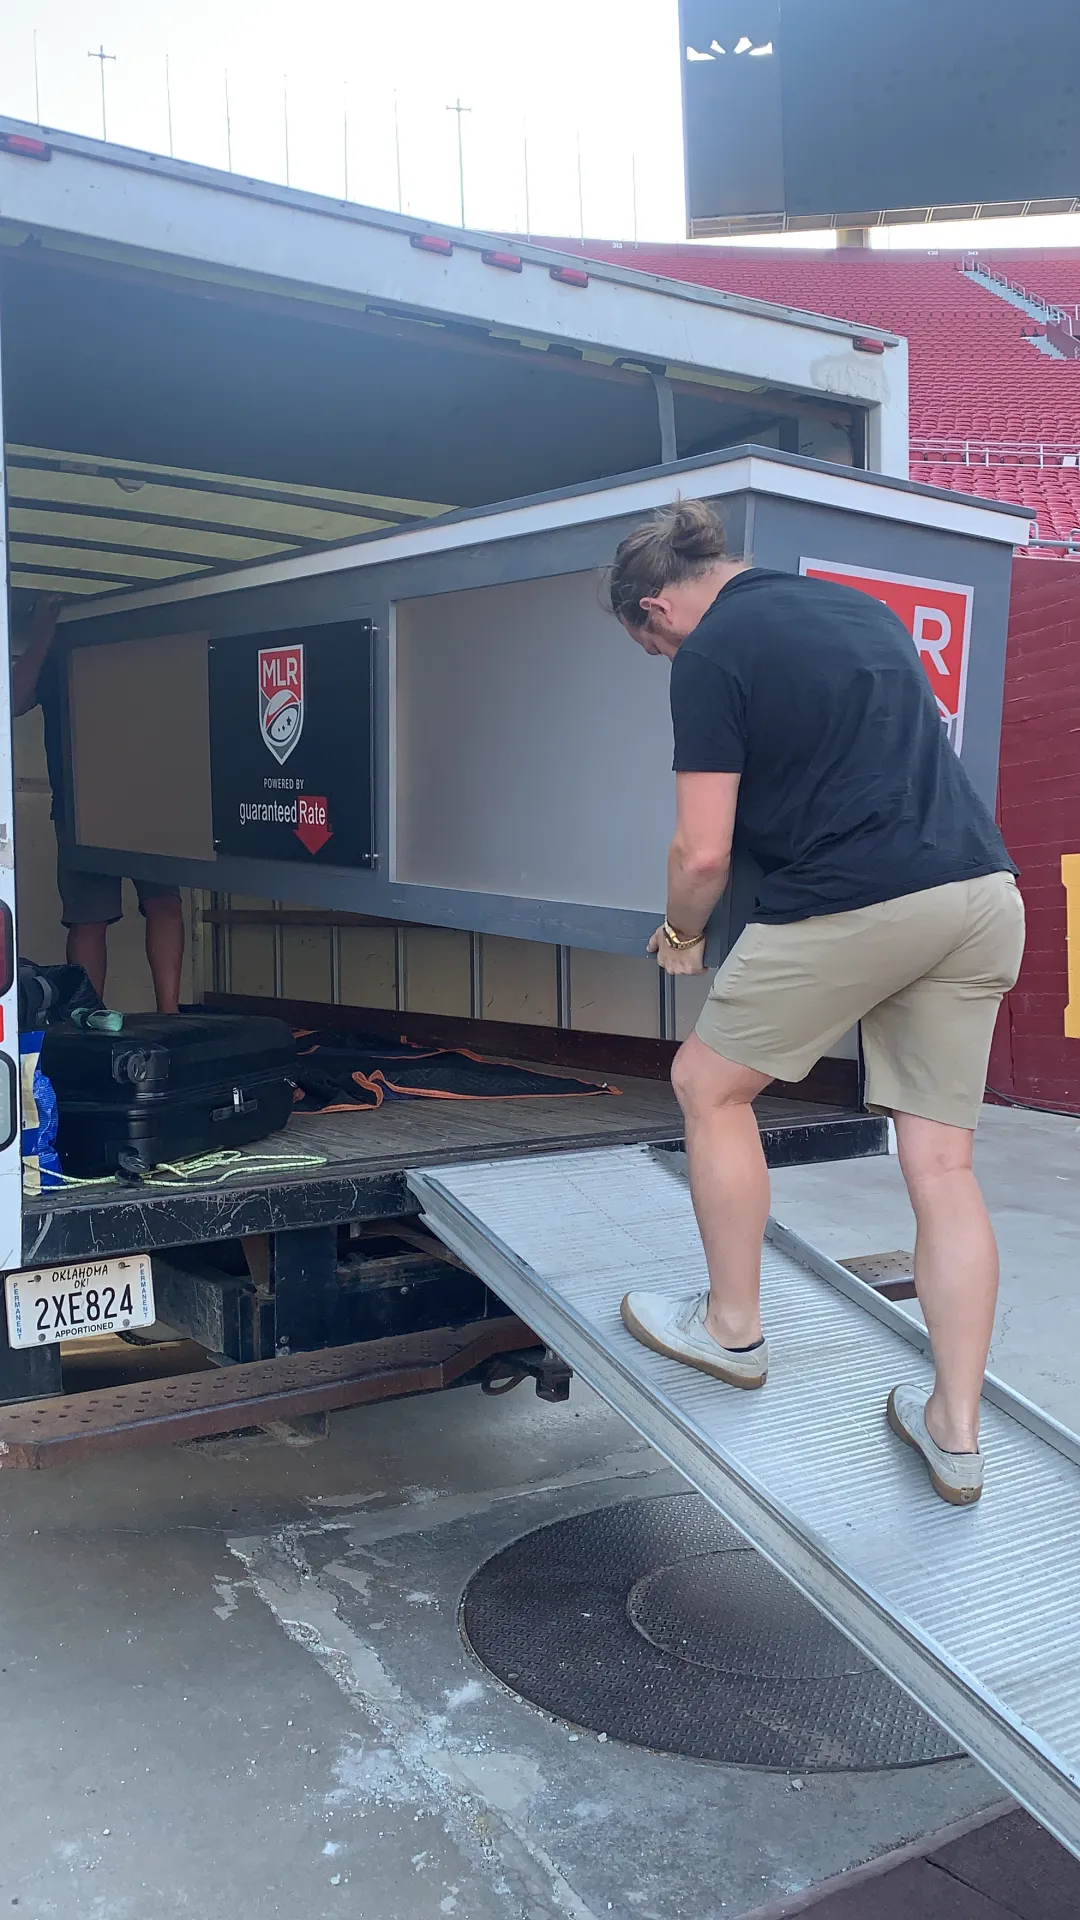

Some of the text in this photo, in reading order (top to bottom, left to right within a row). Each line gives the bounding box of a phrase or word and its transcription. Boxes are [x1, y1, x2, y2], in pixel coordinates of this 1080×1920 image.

[262, 657, 299, 688] MLR
[263, 778, 304, 789] POWERED BY
[239, 800, 326, 826] guaranteed Rate
[51, 1264, 109, 1283] OKLAHOMA
[139, 1263, 148, 1319] PERMANENT
[13, 1282, 23, 1340] PERMANENT
[34, 1283, 134, 1331] 2XE824
[54, 1321, 114, 1339] APPORTIONED
